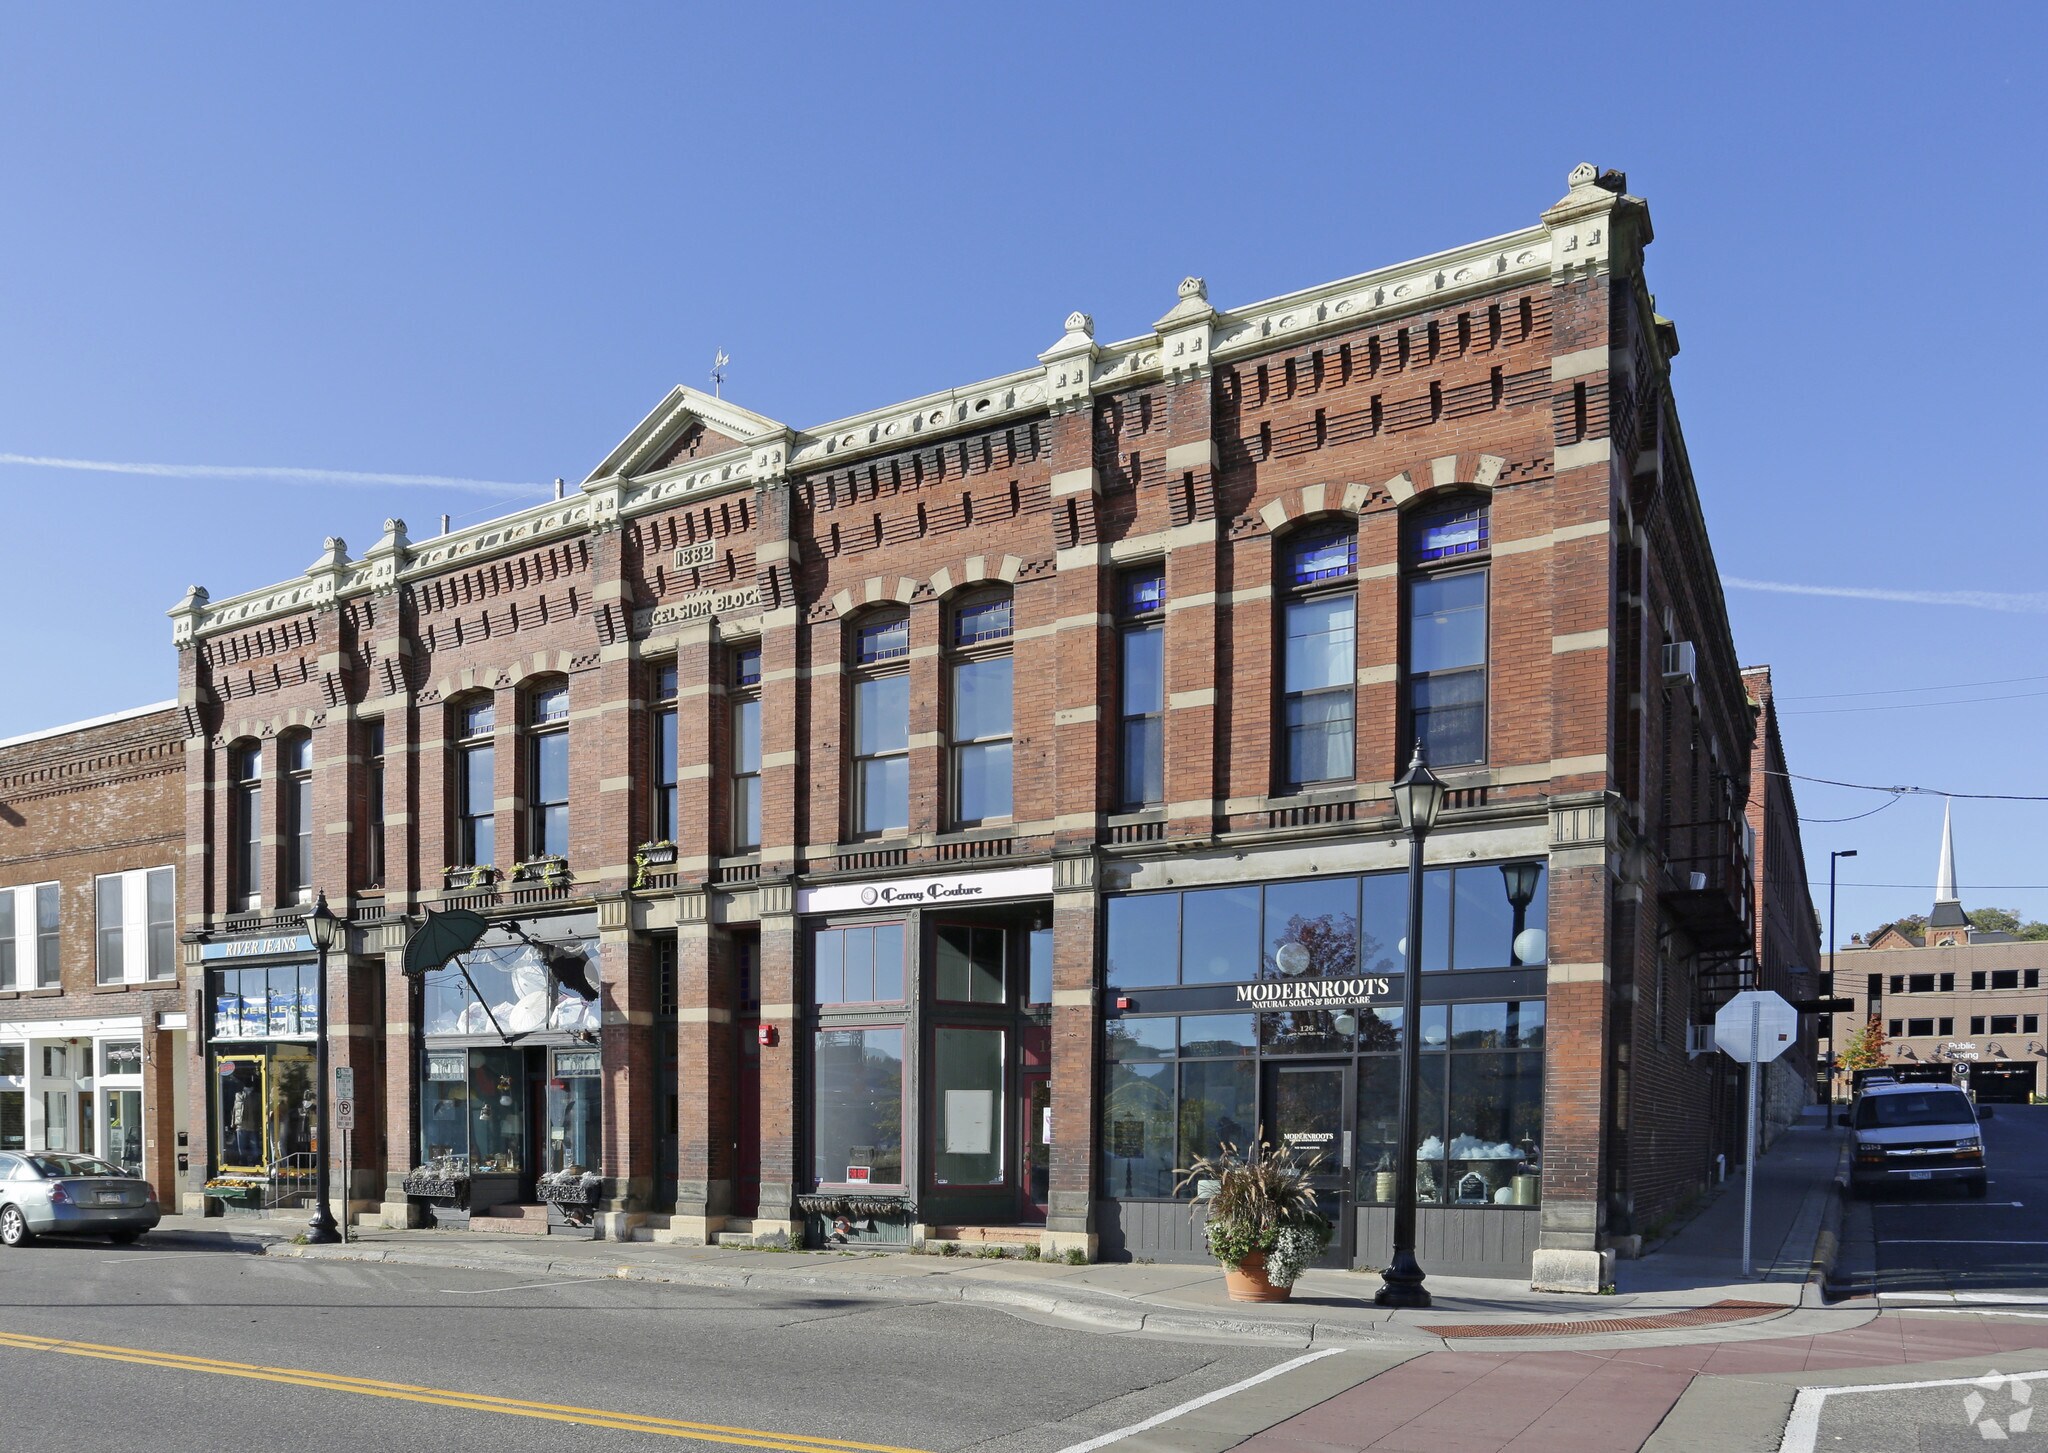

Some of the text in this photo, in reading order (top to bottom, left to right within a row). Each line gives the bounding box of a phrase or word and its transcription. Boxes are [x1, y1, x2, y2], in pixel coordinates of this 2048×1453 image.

[675, 545, 714, 568] 1882
[635, 588, 762, 629] EXCELSIOR BLOCK
[881, 887, 924, 903] Camy
[926, 883, 983, 899] Couture
[226, 937, 298, 956] RIVER JEANS
[1236, 977, 1390, 1002] MODERNROOTS
[1251, 995, 1371, 1009] NATURAL SOAPS & BODY CARE
[1948, 1042, 1976, 1050] Public
[1945, 1052, 1979, 1060] Parking
